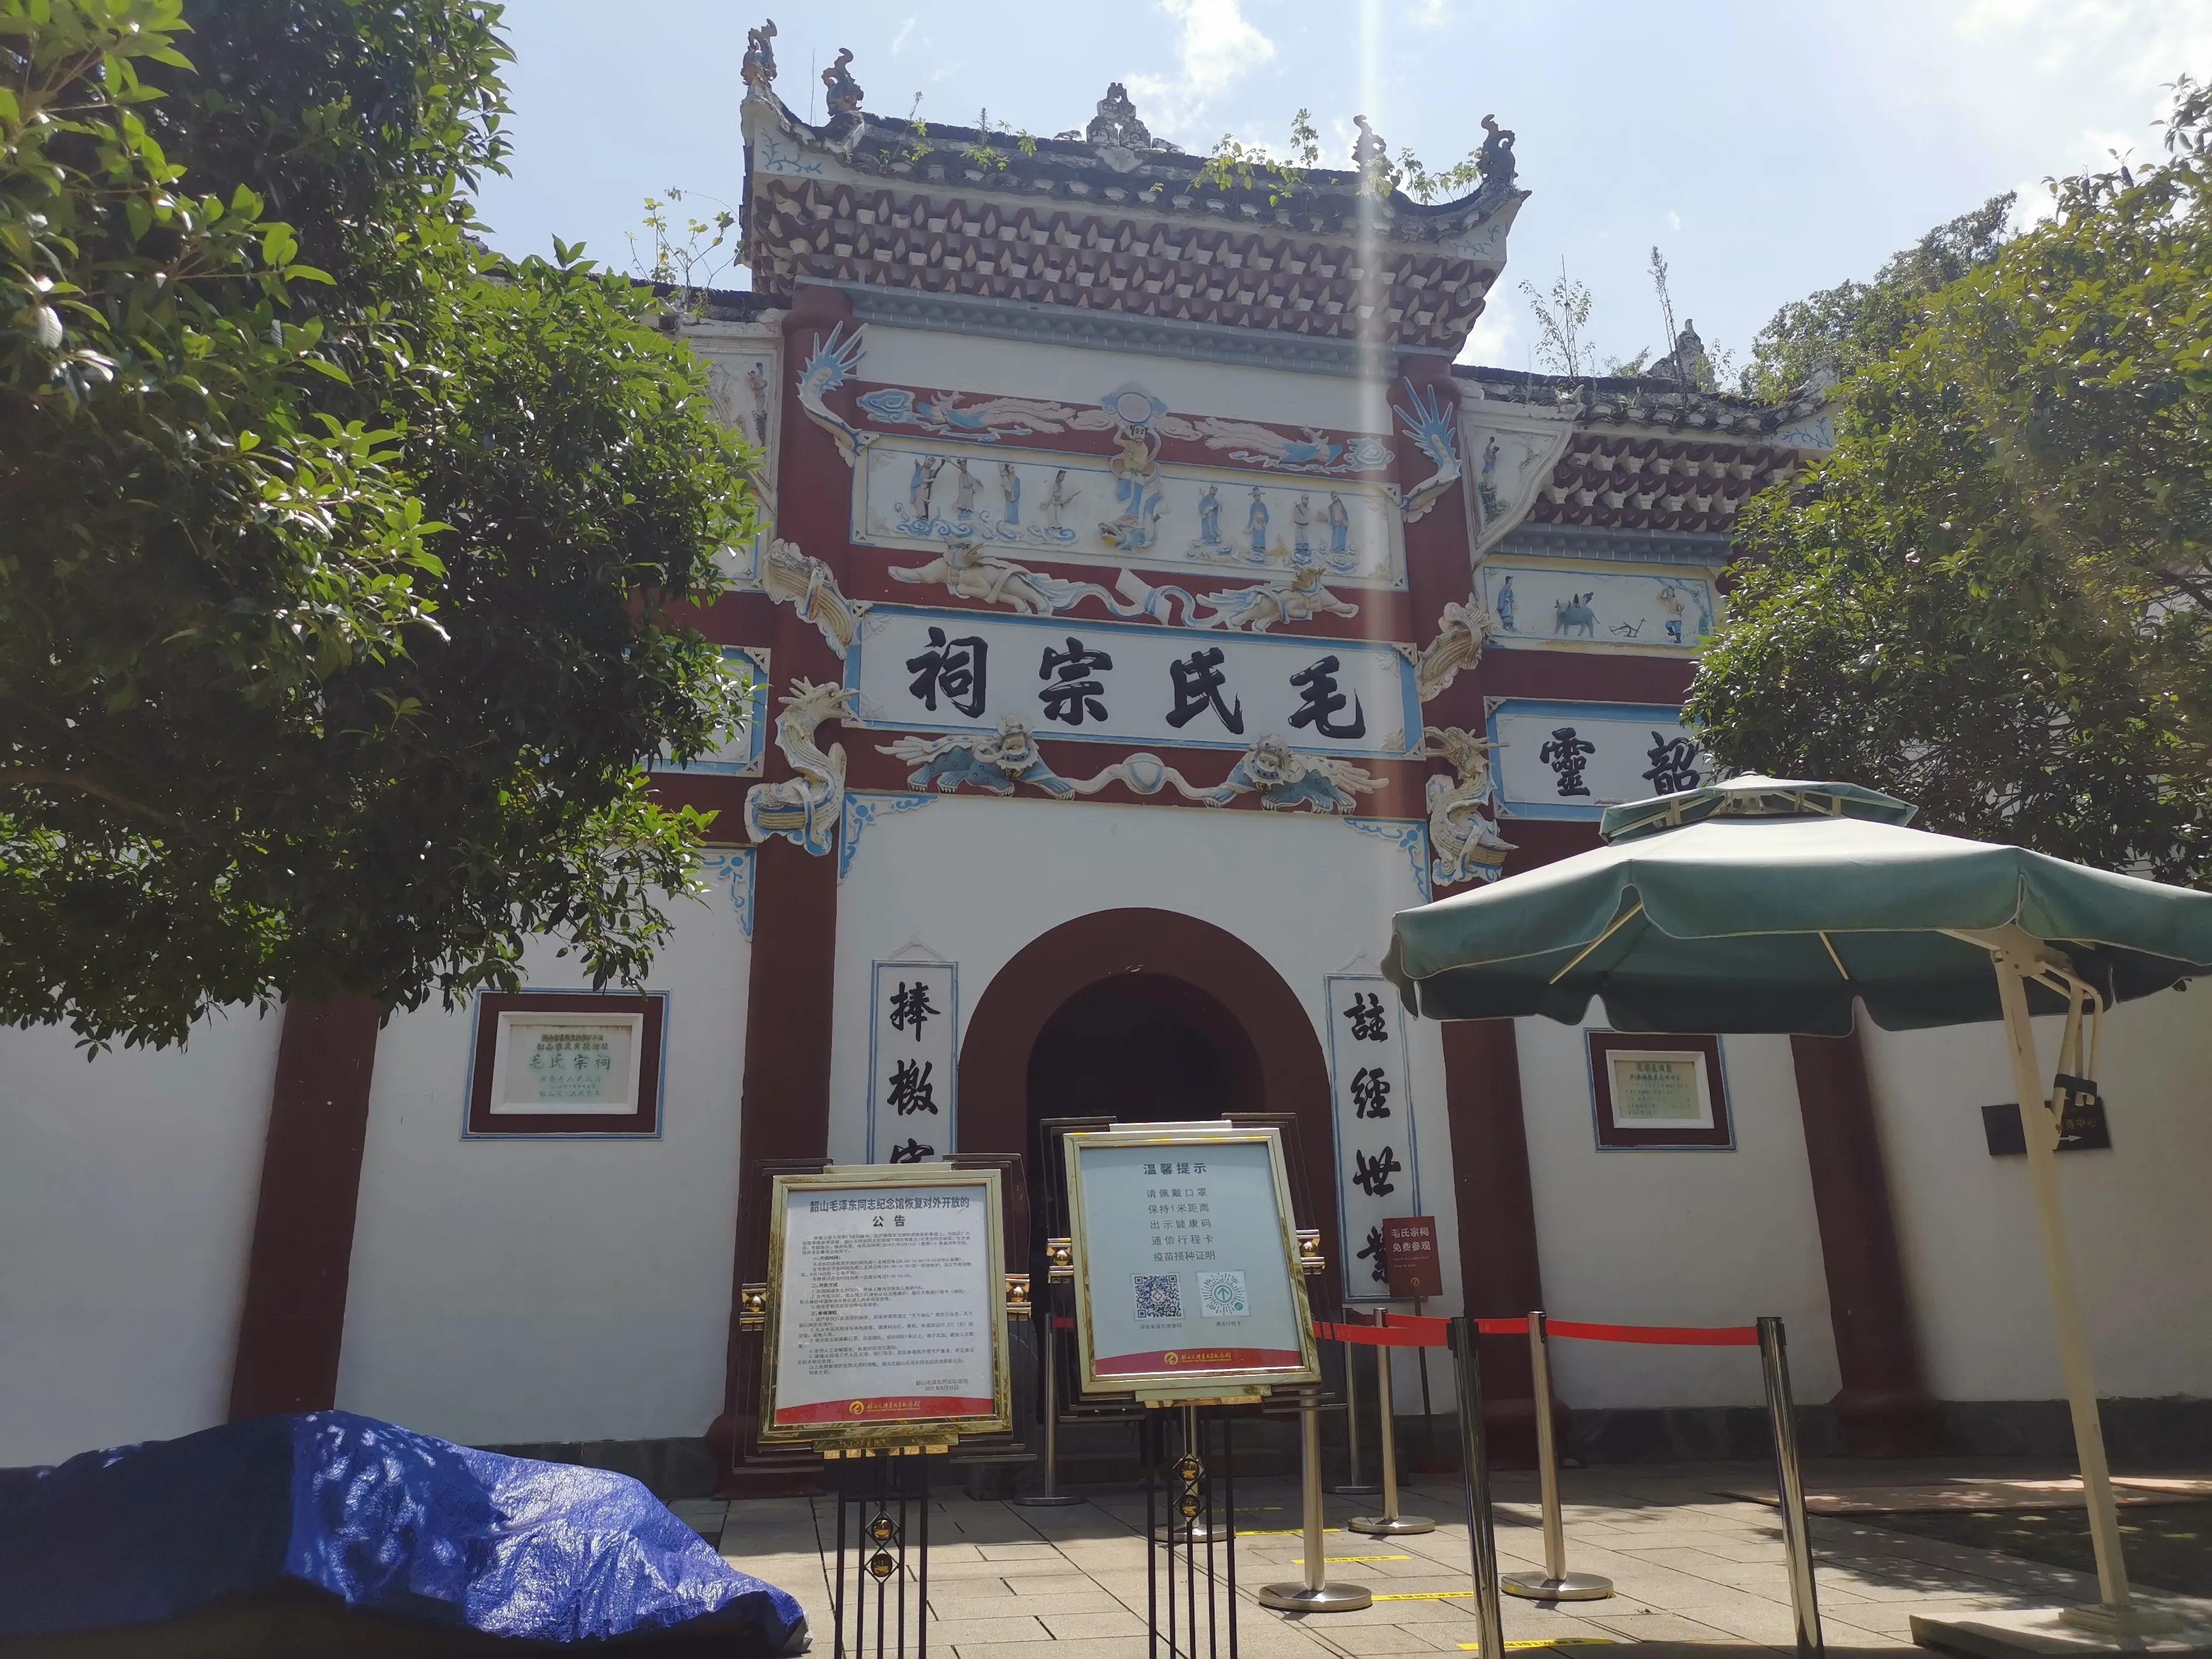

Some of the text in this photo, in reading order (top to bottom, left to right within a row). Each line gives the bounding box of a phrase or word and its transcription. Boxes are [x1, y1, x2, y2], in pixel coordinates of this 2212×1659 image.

[529, 1053, 611, 1071] 毛氏宗祠
[1143, 1162, 1207, 1175] 温馨提示
[1147, 1188, 1207, 1198] 请佩戴口罩
[810, 1196, 970, 1212] 韶山毛泽东同志纪念馆恢复对外开放的
[1148, 1203, 1209, 1214] 保持1米距离
[1150, 1219, 1211, 1229] 出示健康码
[1391, 1227, 1429, 1238] 毛氏宗祠
[1151, 1235, 1214, 1245] 通信行程卡
[1393, 1241, 1431, 1252] 免费参观
[1153, 1250, 1216, 1261] 疫苗接种证明
